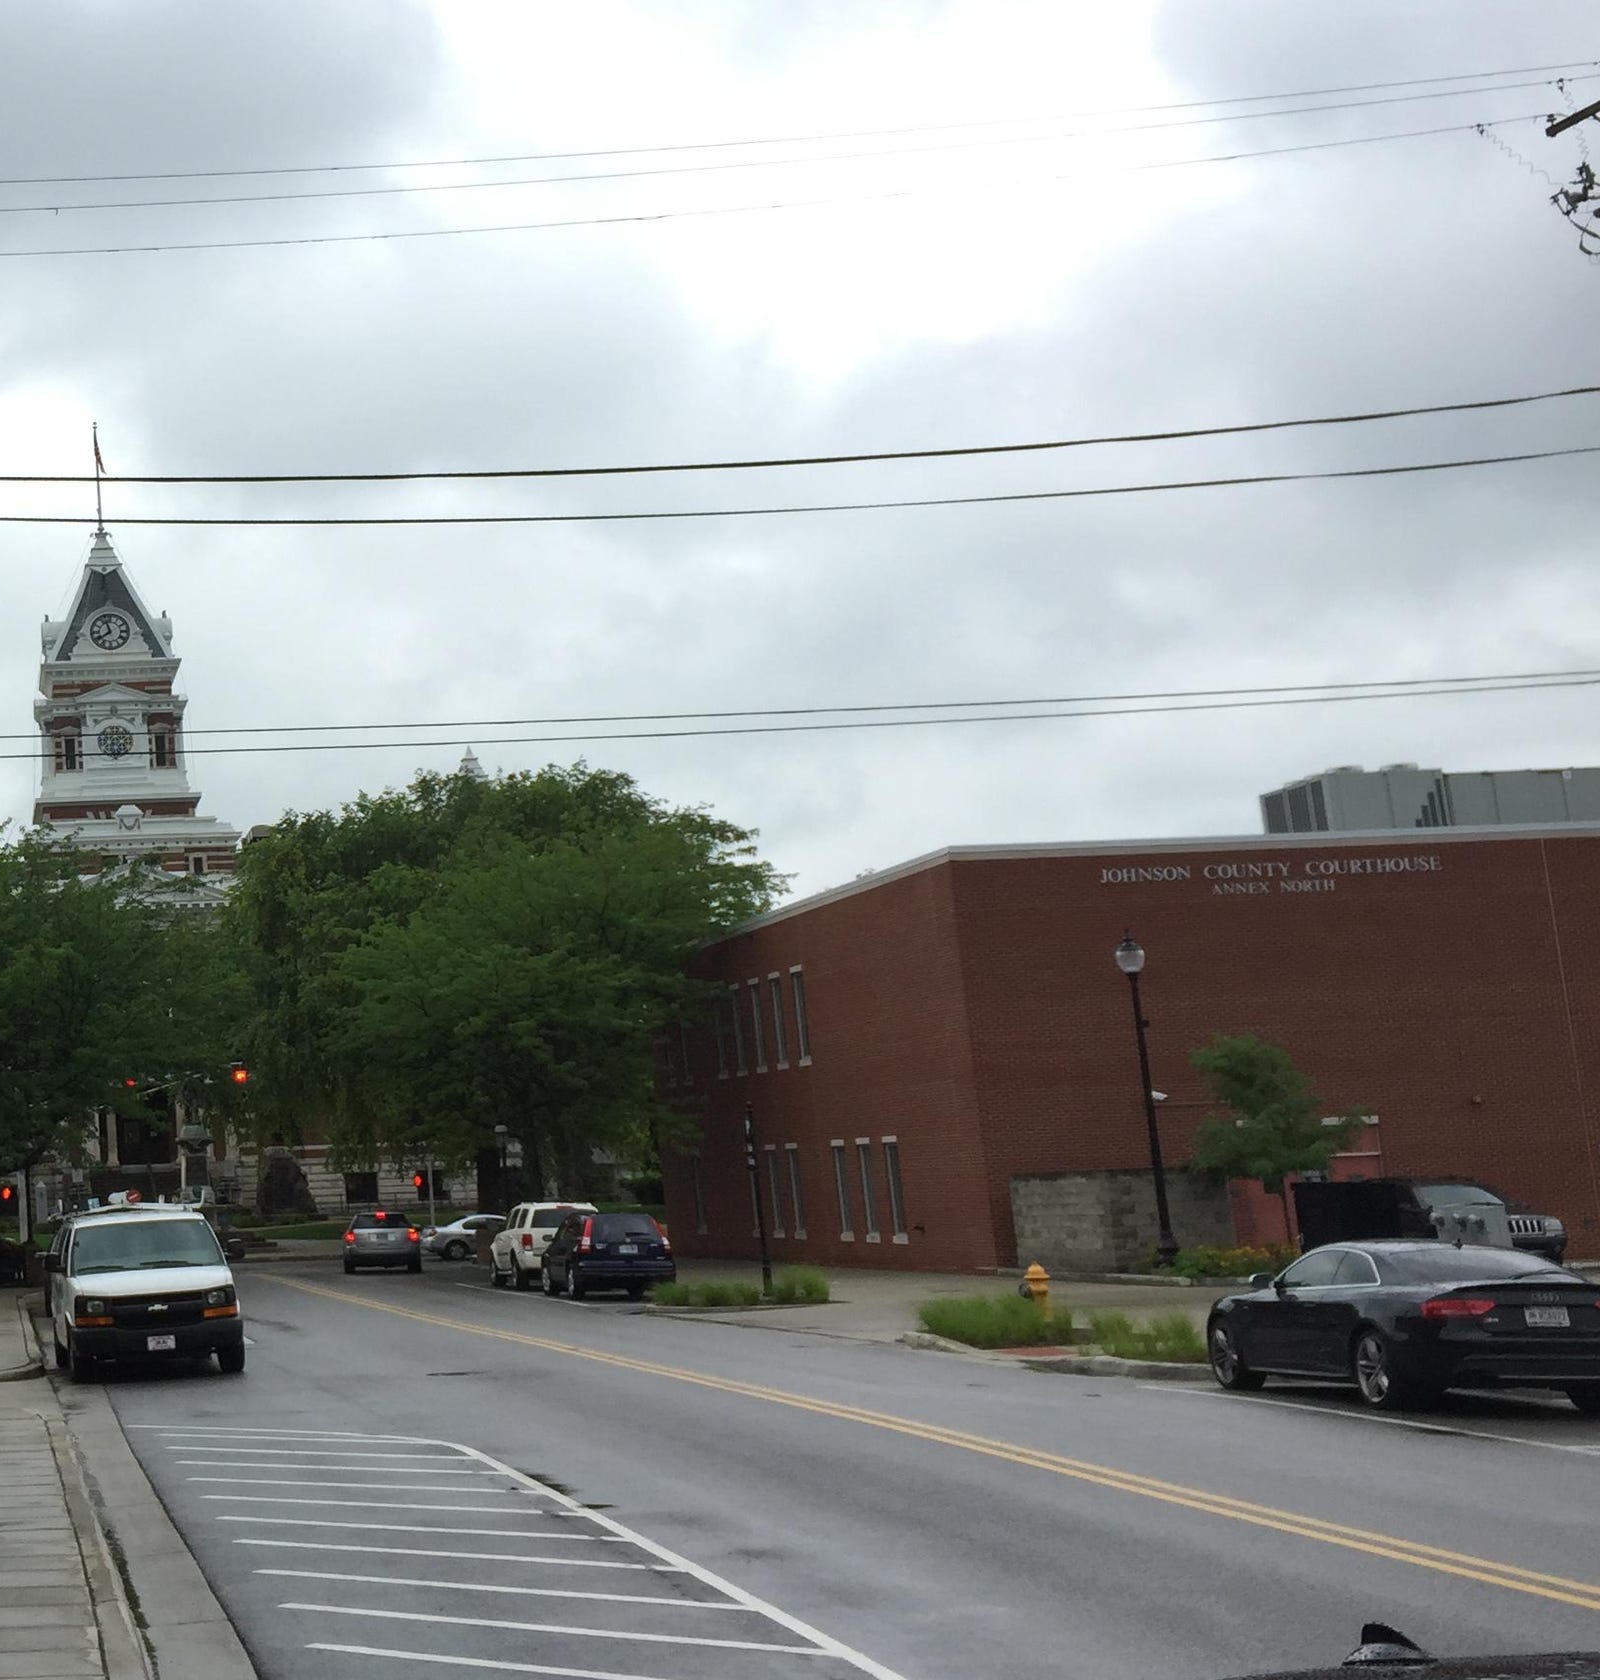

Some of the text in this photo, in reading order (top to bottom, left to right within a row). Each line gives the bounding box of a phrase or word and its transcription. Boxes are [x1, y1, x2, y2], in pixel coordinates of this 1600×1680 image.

[1100, 856, 1442, 883] JOHNSON COUNTY COURTHOUSE
[1212, 878, 1335, 896] ANNEX NORTH
